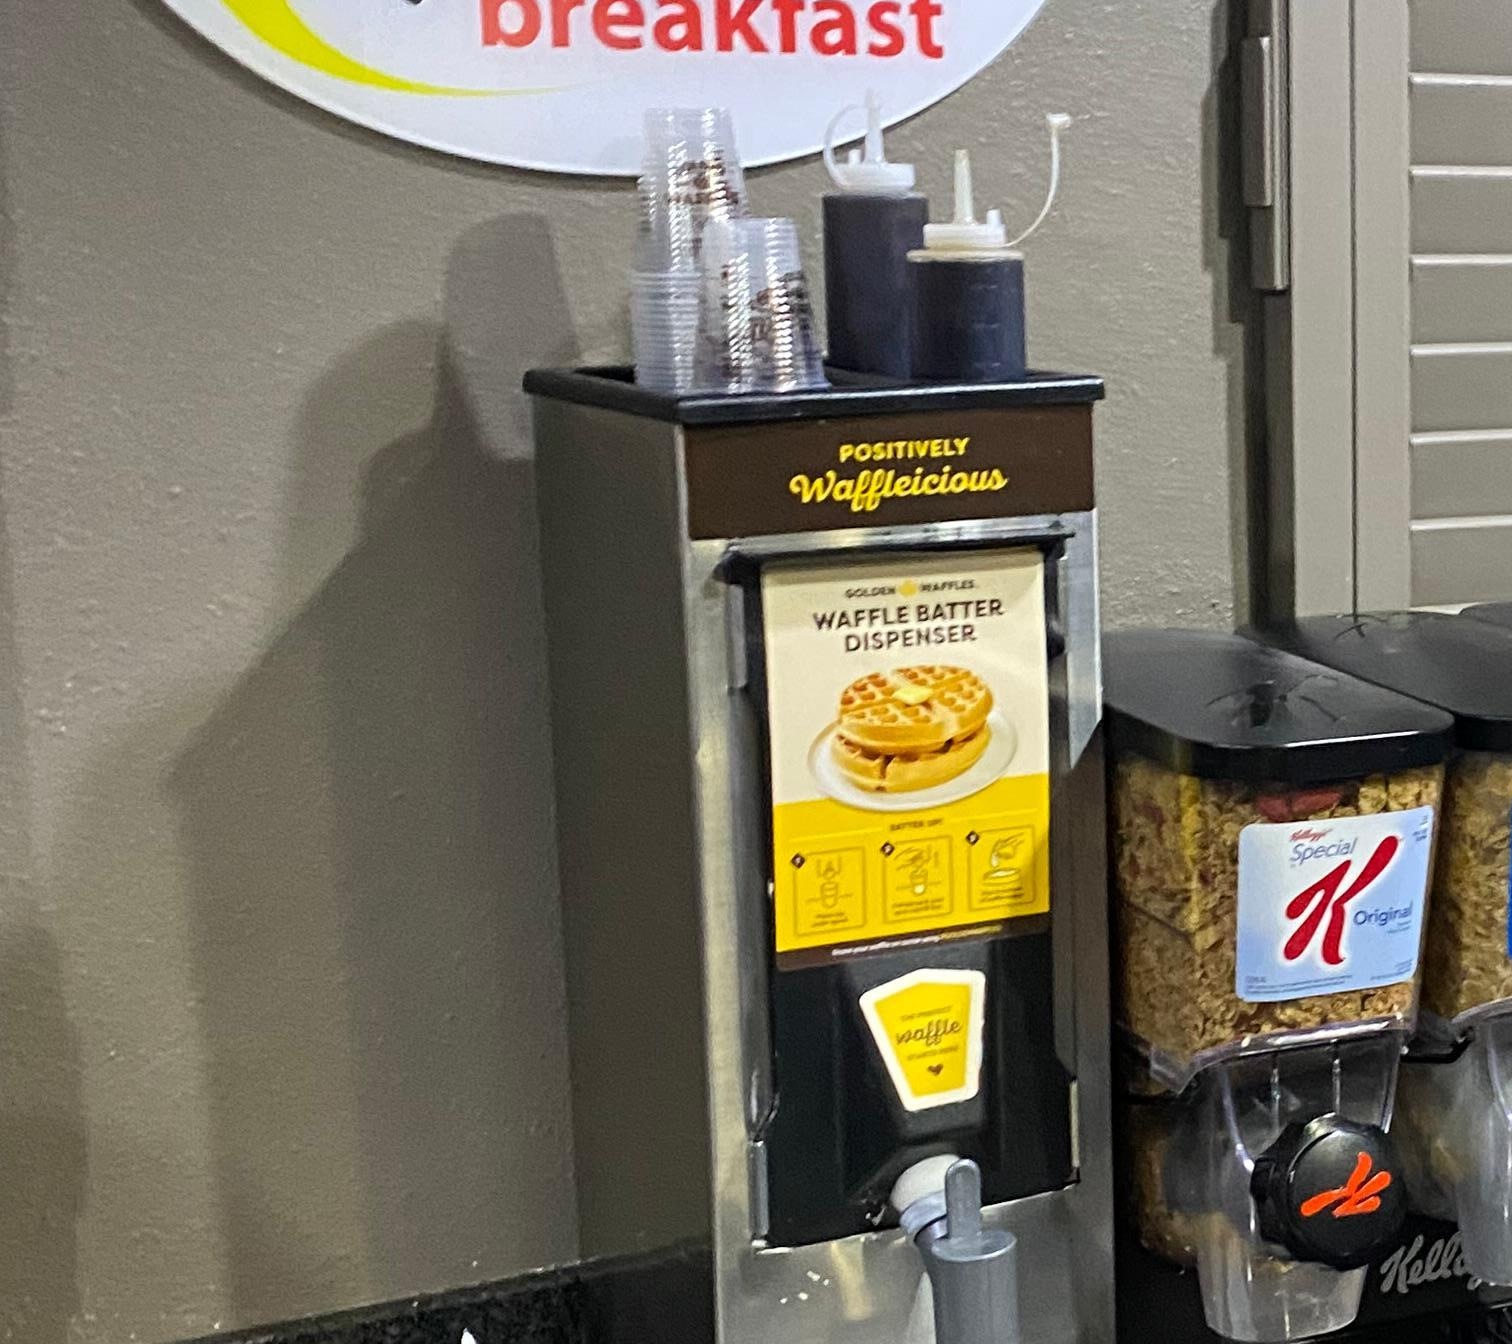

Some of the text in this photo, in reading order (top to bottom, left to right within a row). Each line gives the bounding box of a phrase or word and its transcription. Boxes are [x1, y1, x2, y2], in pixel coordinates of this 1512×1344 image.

[838, 436, 971, 463] POSITIVELY
[788, 465, 1009, 512] Waffleicious
[845, 585, 897, 598] GOLDEN
[813, 598, 1004, 631] WAFFLE BATTER
[844, 624, 978, 653] DISPENSER
[1290, 836, 1359, 865] Special
[1283, 834, 1400, 966] K
[1352, 900, 1414, 926] Original
[896, 1017, 963, 1047] waffle
